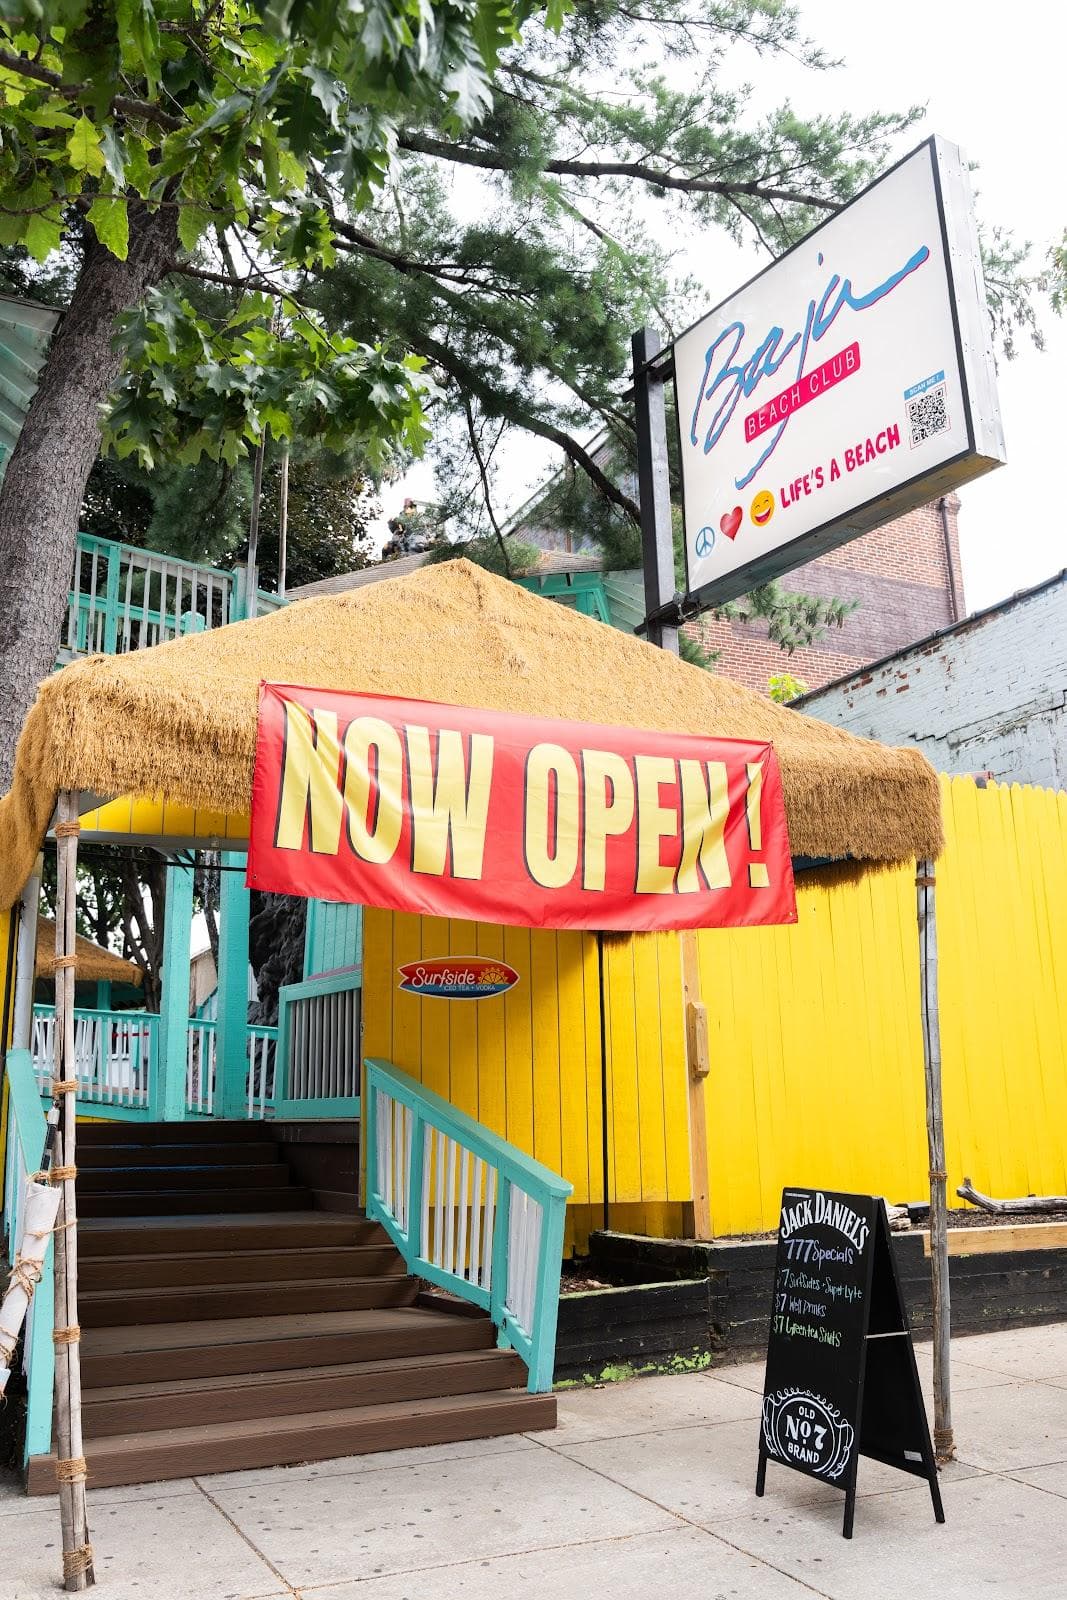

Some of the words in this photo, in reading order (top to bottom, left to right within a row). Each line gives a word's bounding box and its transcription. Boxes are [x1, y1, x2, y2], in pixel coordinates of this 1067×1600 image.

[690, 245, 930, 490] Baja
[747, 385, 801, 436] BEACH
[809, 349, 855, 393] CLUB
[909, 382, 926, 396] SCAN
[780, 466, 824, 508] LIFE'S
[830, 458, 841, 482] A
[844, 423, 901, 472] BEACH
[273, 700, 495, 880] NOW
[411, 967, 476, 988] Surfside
[781, 1199, 814, 1239] JACK
[814, 1192, 871, 1250] DANIEL'S
[812, 1239, 854, 1270] Specials
[774, 1314, 785, 1334] $7
[798, 1405, 816, 1420] OLD
[787, 1442, 820, 1464] BRAND
